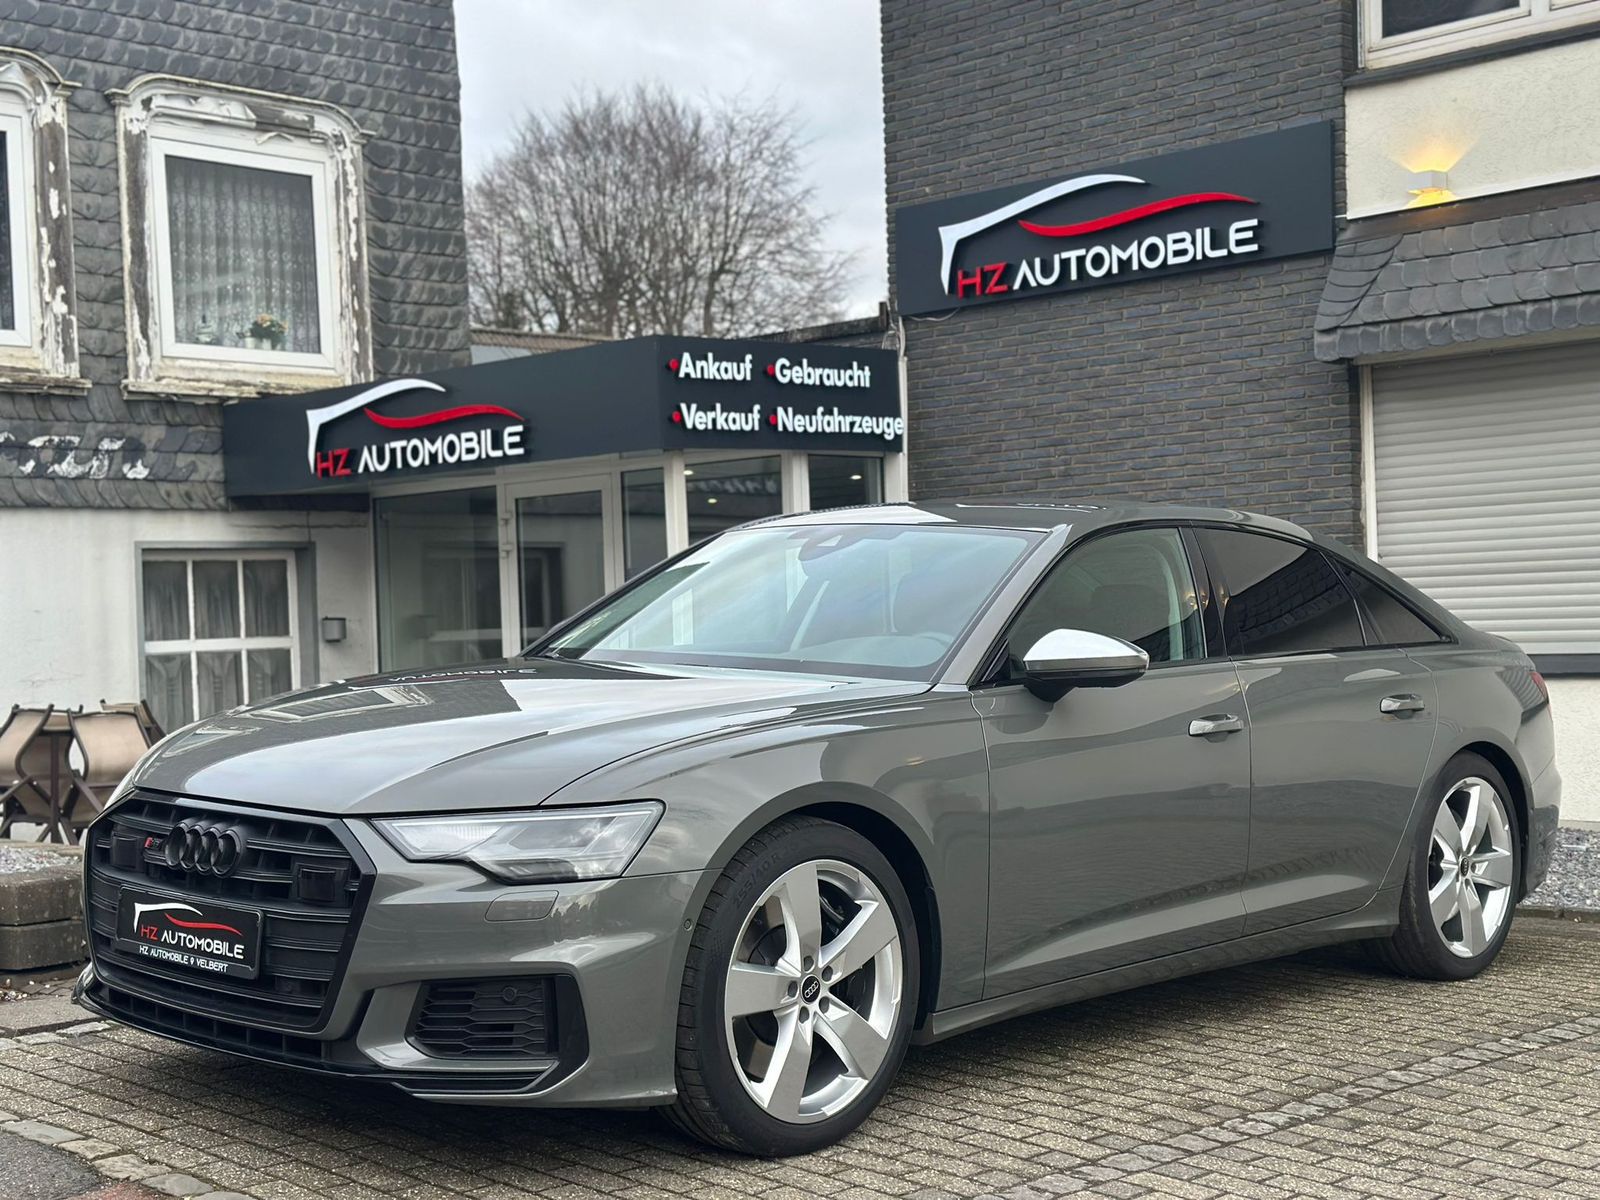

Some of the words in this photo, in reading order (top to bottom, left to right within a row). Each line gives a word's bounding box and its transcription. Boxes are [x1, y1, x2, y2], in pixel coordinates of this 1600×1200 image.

[957, 262, 1008, 298] HZ
[1013, 218, 1259, 290] AUTOMOBILE
[678, 352, 753, 381] Ankauf
[775, 357, 871, 388] Gebraucht
[680, 402, 761, 432] Verkauf
[776, 406, 904, 440] Neufahrzeuge
[316, 448, 352, 480] HZ
[358, 425, 525, 474] AUTOMOBILE
[139, 945, 149, 956] HZ
[150, 948, 188, 964] AUTOMOBILE
[196, 958, 229, 973] VELBERT
[141, 924, 158, 941] HZ
[161, 929, 245, 960] AUTOMOBILE
